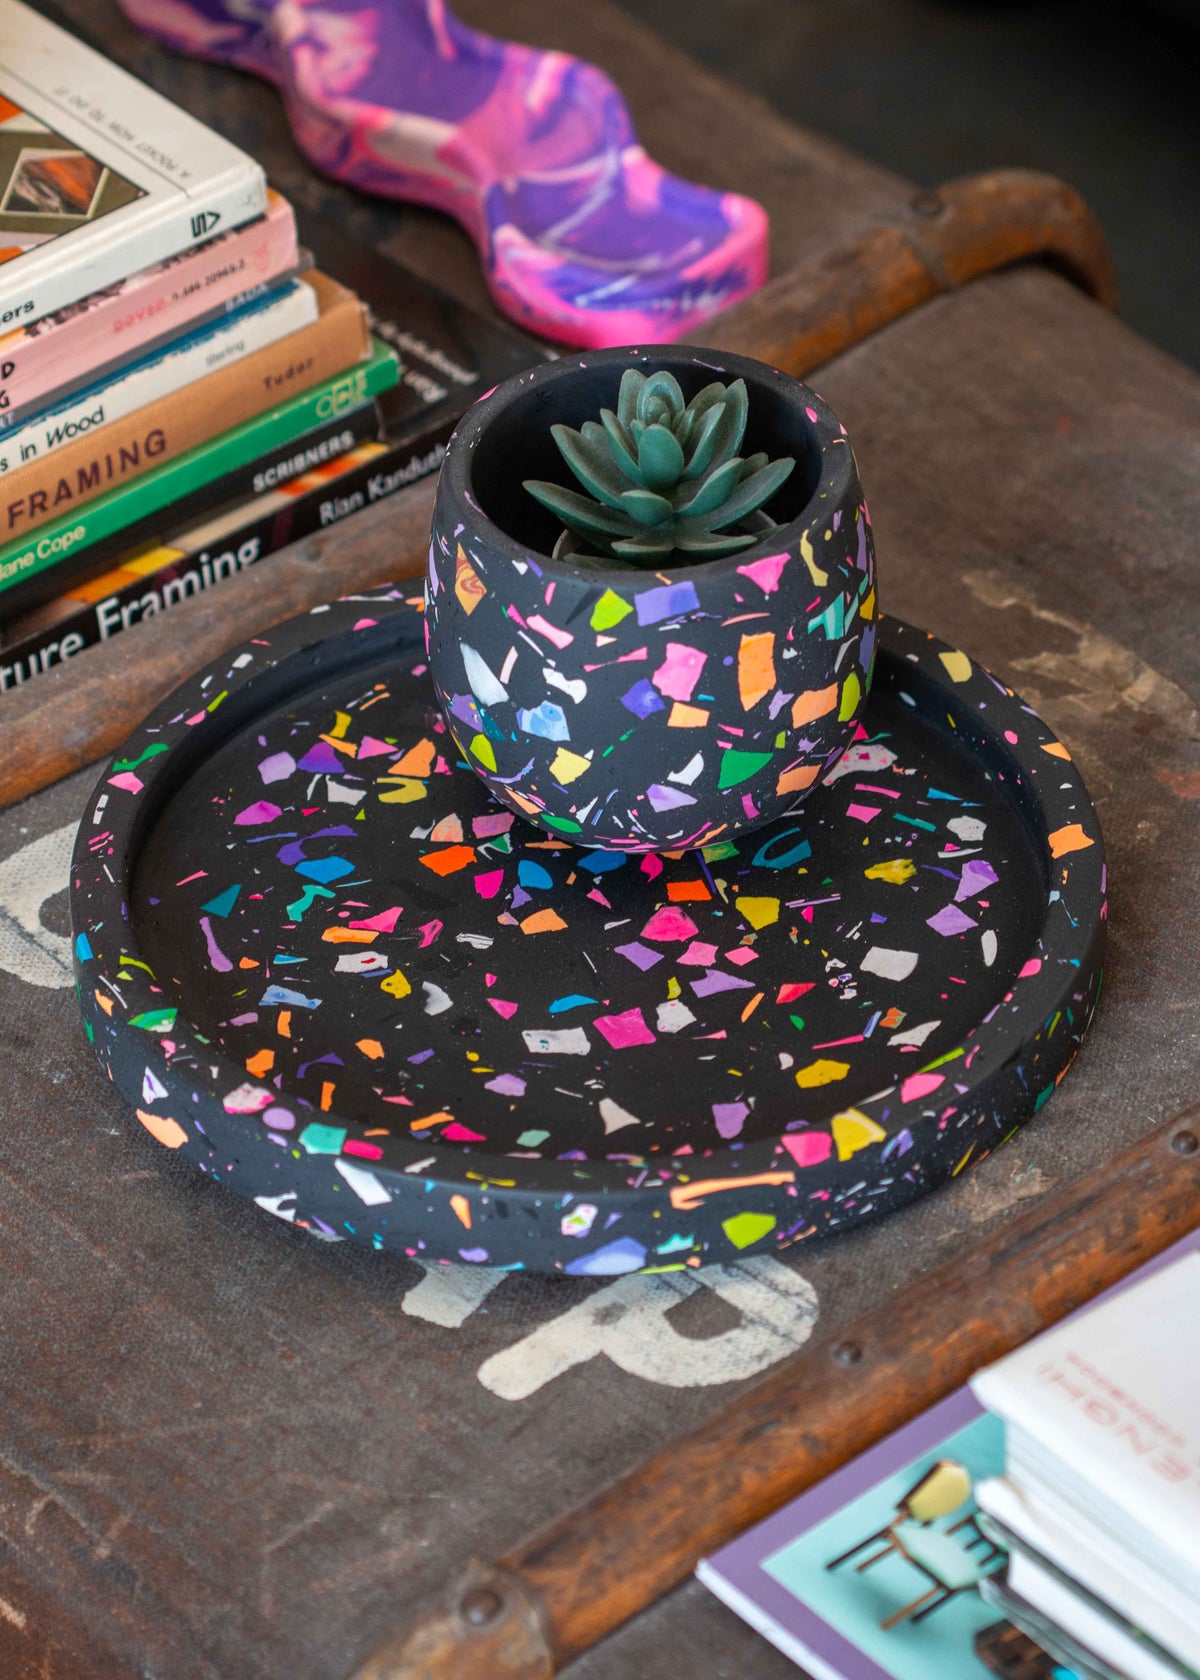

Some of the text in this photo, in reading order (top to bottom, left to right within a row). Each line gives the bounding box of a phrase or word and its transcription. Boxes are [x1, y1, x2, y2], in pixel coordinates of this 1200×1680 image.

[20, 443, 37, 462] in
[46, 406, 105, 448] Wood
[253, 430, 355, 492] SCRIBNERS
[8, 429, 167, 529] FRAMING
[37, 525, 86, 559] Cope
[96, 537, 261, 640] Framing
[319, 491, 363, 525] Rian
